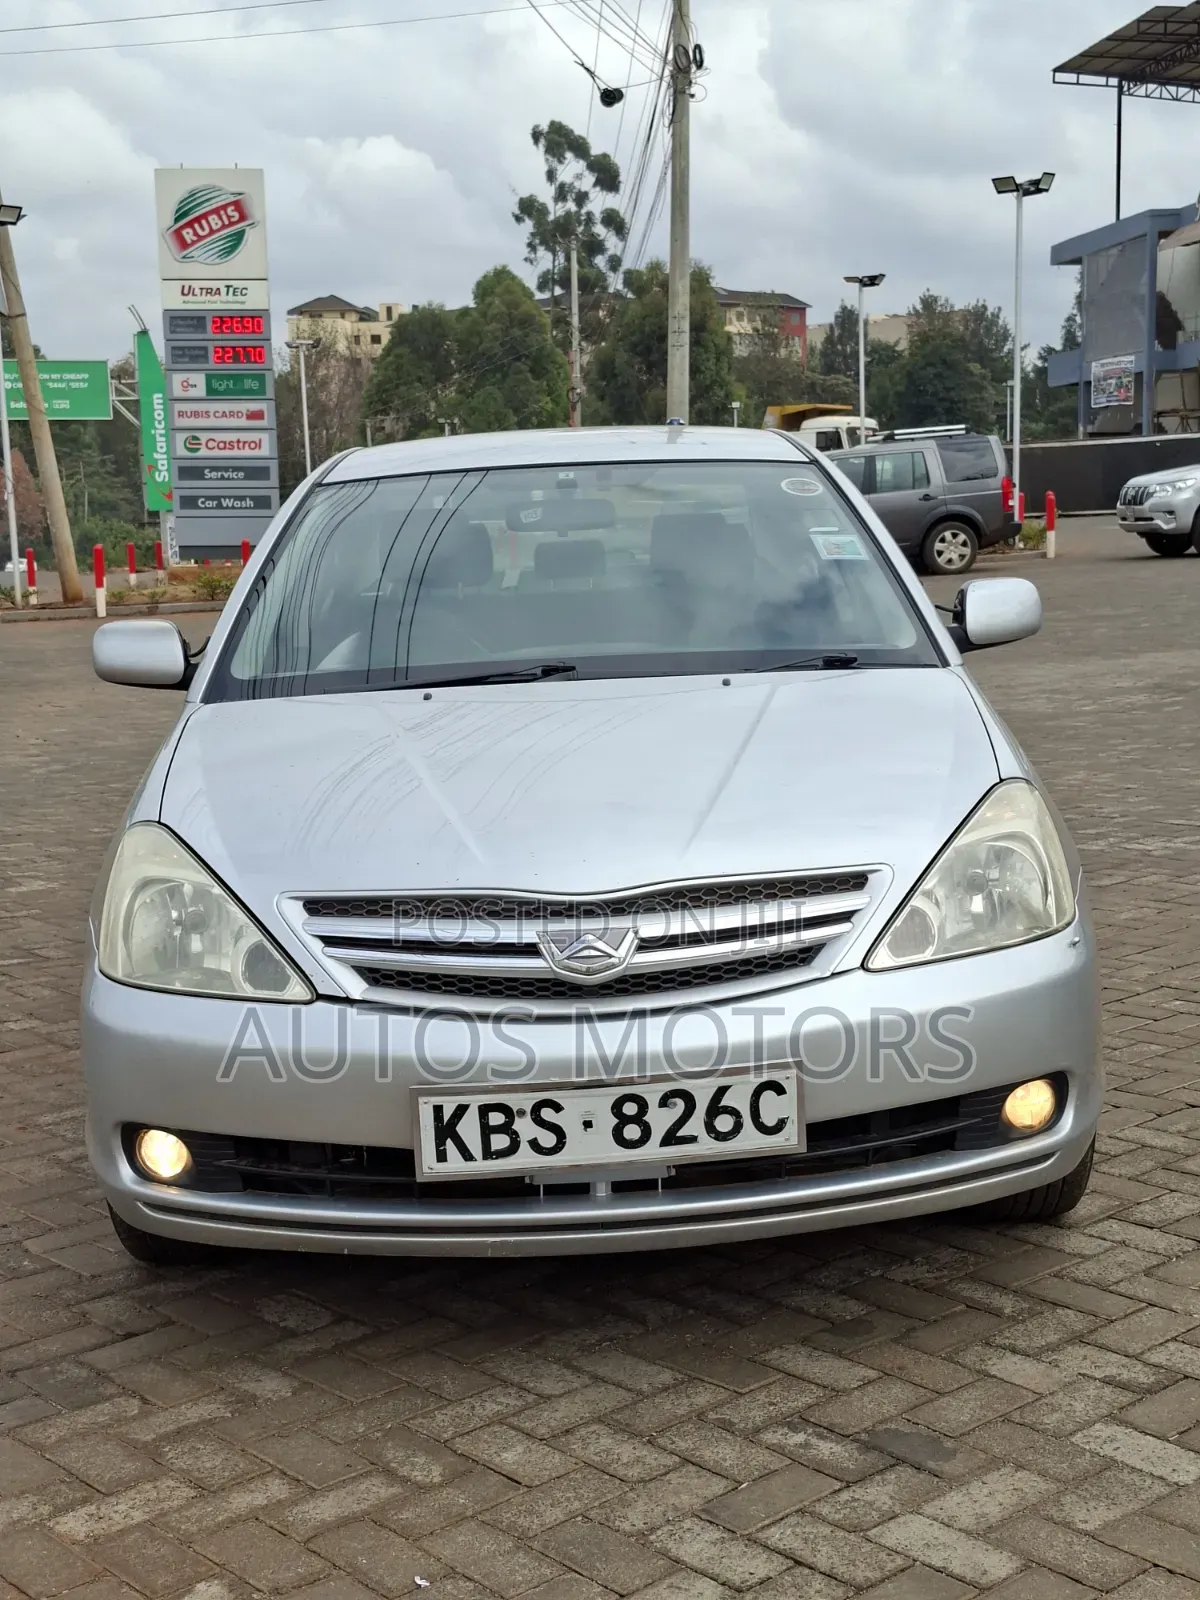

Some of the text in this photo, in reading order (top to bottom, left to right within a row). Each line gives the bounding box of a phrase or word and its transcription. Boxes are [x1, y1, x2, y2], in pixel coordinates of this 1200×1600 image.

[224, 284, 248, 297] TEC
[211, 316, 263, 334] 226.90
[213, 346, 265, 364] 227.70
[213, 410, 244, 419] CARD
[152, 393, 169, 483] Safaricom
[205, 438, 262, 451] Castrol
[204, 469, 245, 479] Service
[198, 498, 254, 508] Car Wash
[432, 1079, 790, 1164] KBS 826C
